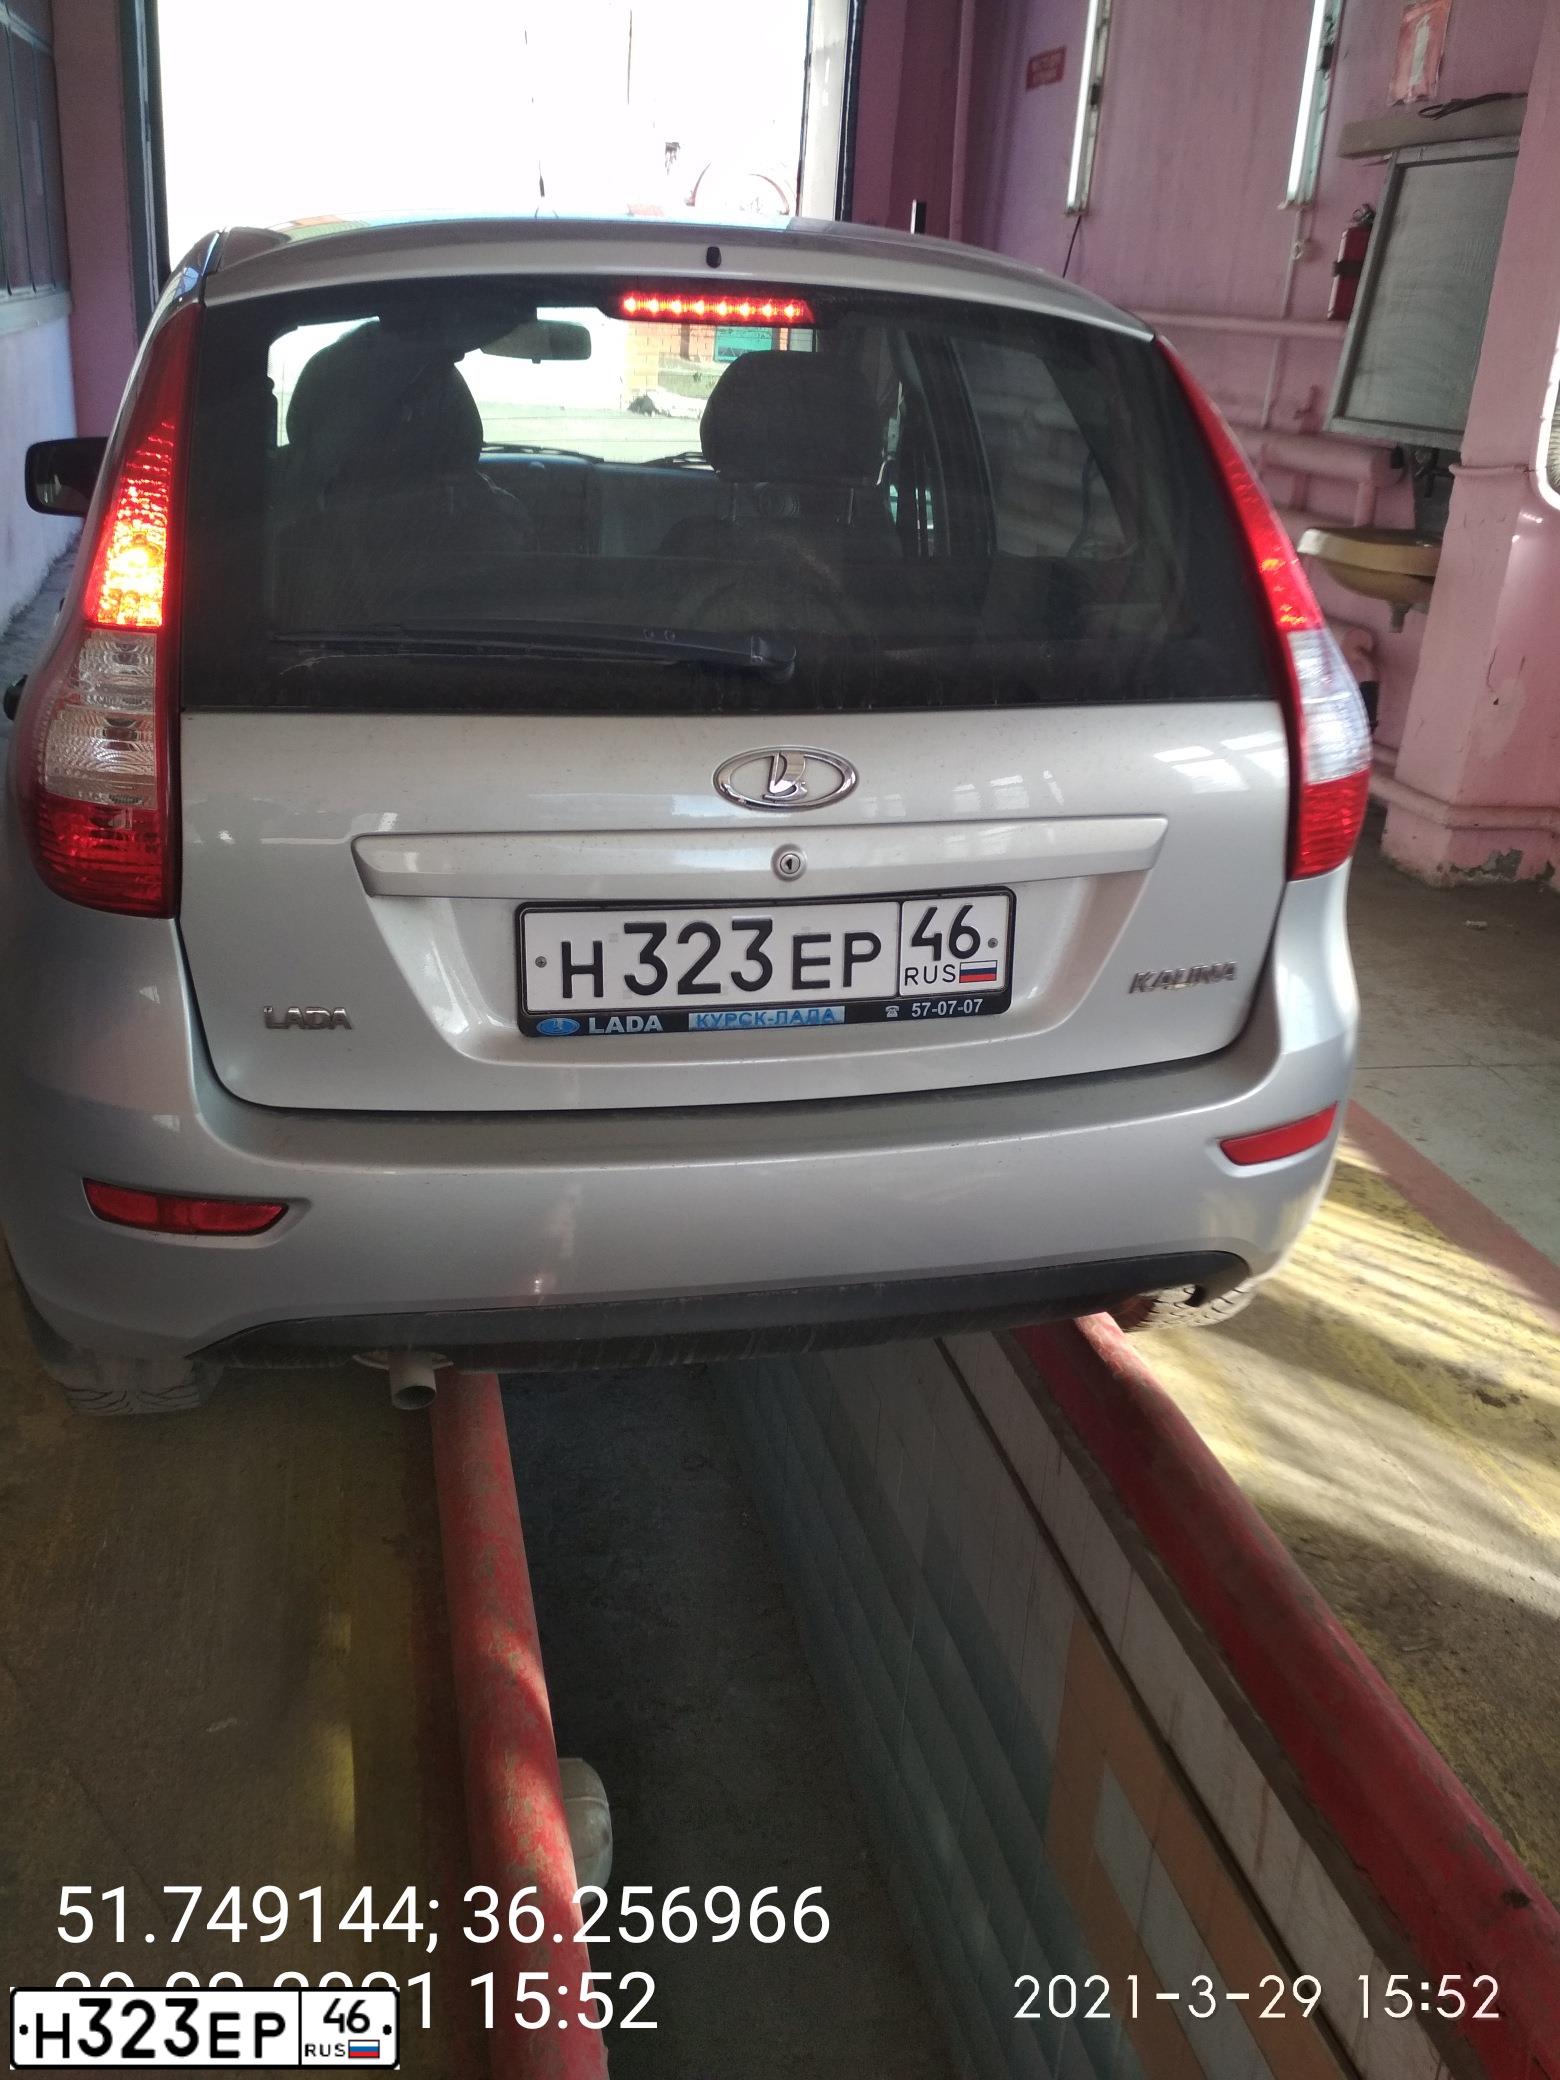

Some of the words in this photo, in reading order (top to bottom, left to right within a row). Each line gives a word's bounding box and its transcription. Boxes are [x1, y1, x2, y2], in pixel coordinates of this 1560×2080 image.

[911, 904, 981, 962] 46
[904, 964, 956, 987] RUS
[264, 1006, 352, 1030] LADA
[696, 1007, 837, 1029] КУРСК-ЛАДА
[911, 999, 983, 1018] 57-07-07
[588, 1014, 664, 1034] LADA
